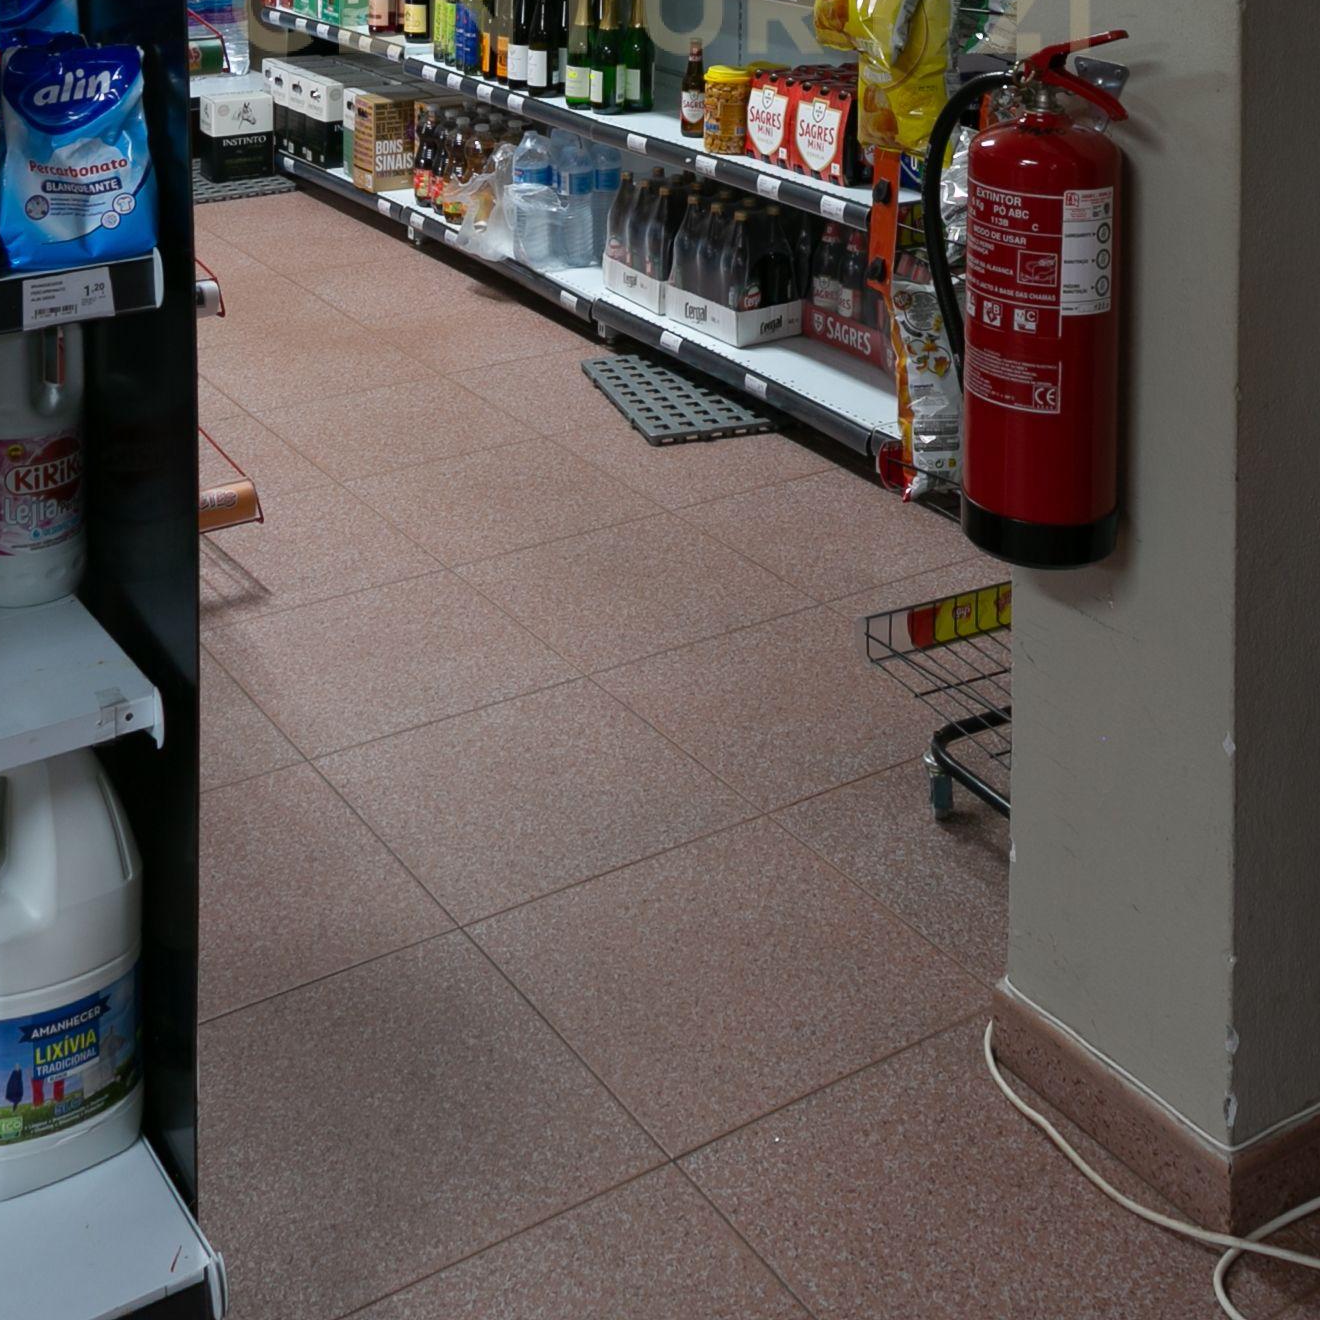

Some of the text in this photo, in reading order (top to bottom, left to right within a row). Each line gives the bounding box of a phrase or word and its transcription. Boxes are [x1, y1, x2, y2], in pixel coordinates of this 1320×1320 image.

[33, 68, 111, 106] alin
[749, 106, 782, 129] SAGRES
[222, 135, 267, 147] INSTINTO
[798, 120, 835, 145] SAGRES
[375, 139, 403, 154] BONS
[29, 158, 128, 178] Percarbonato
[375, 153, 414, 171] SINAIS
[45, 179, 120, 193] BLANQUEANTE
[977, 187, 1021, 207] EXTINTOR
[993, 203, 1030, 220] PÓ ABC
[1004, 234, 1027, 246] USAR
